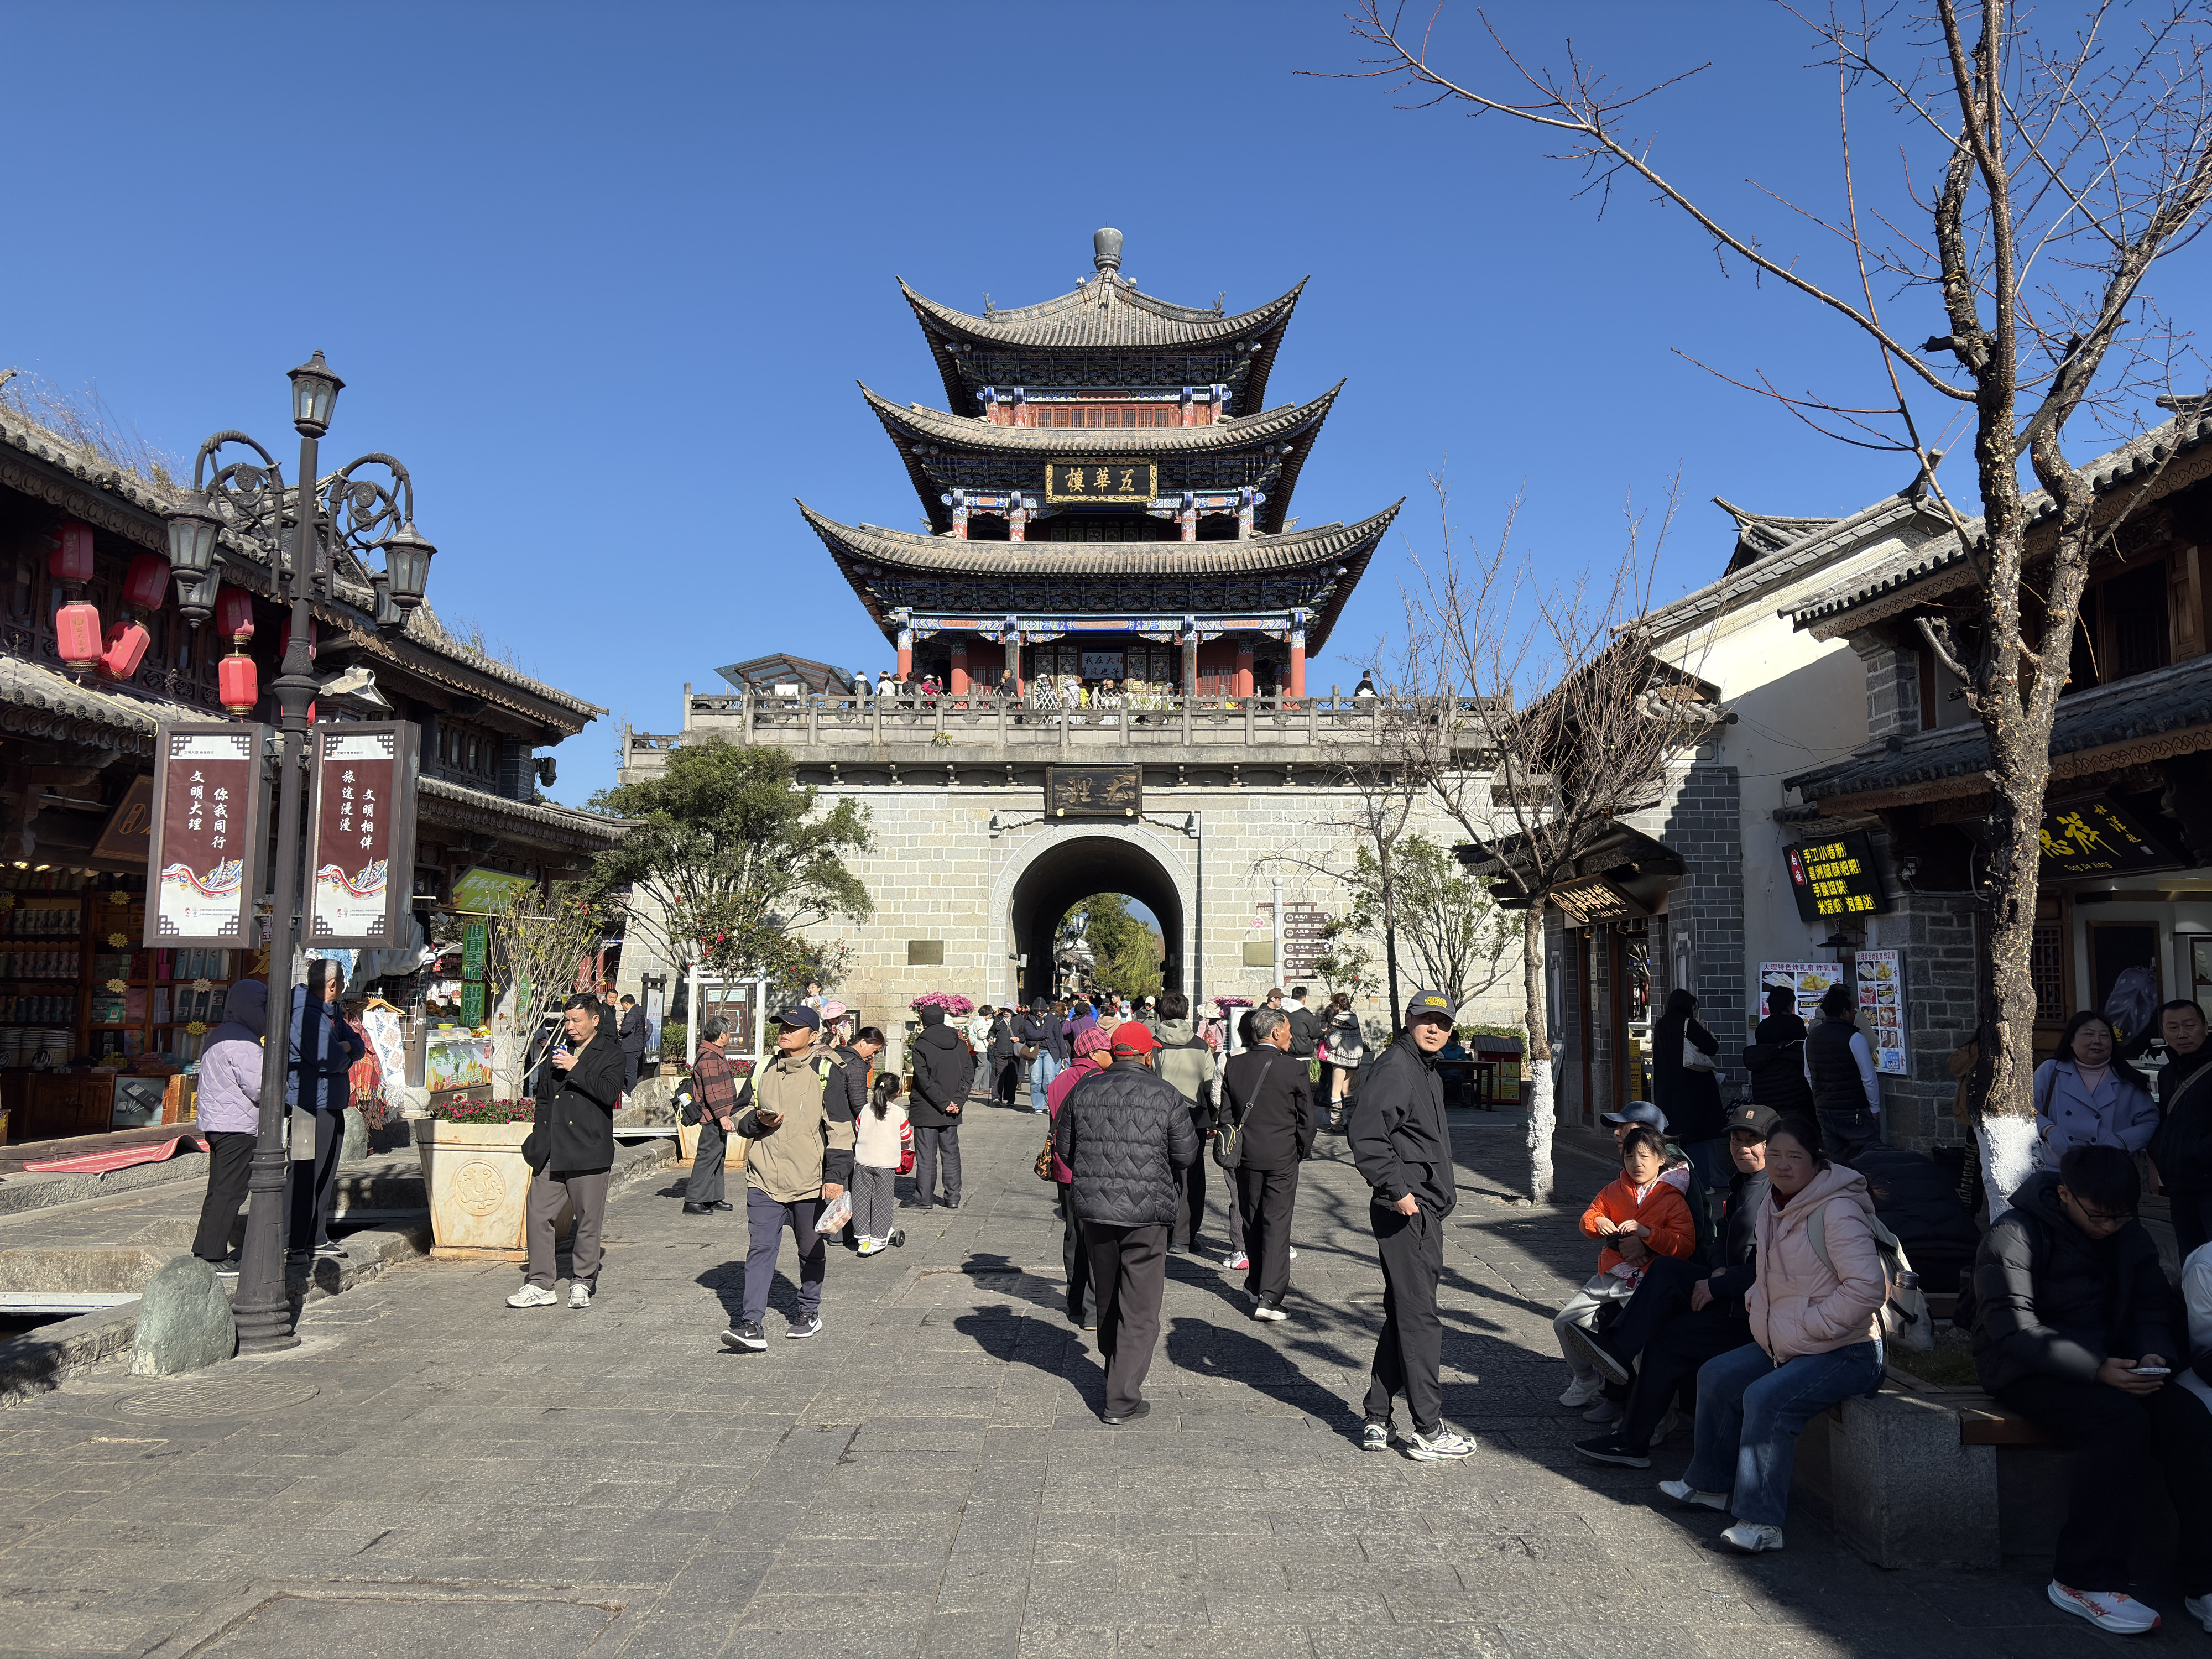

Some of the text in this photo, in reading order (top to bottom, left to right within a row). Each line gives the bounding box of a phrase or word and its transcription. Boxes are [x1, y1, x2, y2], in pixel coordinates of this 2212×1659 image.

[1065, 467, 1134, 493] 五華樓
[1082, 666, 1123, 676] 等风也等
[1085, 655, 1124, 665] 我在大理
[188, 770, 205, 830] 文明大理
[340, 770, 356, 832] 旅途漫漫
[211, 787, 228, 849] 你我同行
[359, 789, 375, 851] 文明相伴
[1803, 842, 1846, 863] 手工小卷粉
[1791, 855, 1803, 882] 白族
[1808, 858, 1860, 880] 喜洲破酥粑粑
[1817, 893, 1875, 915] 米凉虾 泡鲁达
[463, 924, 484, 1027] 健康美味 超好吃
[1425, 1000, 1447, 1009] WARS
[435, 1052, 467, 1067] 高原水果
[451, 1067, 482, 1084] 自然味道
